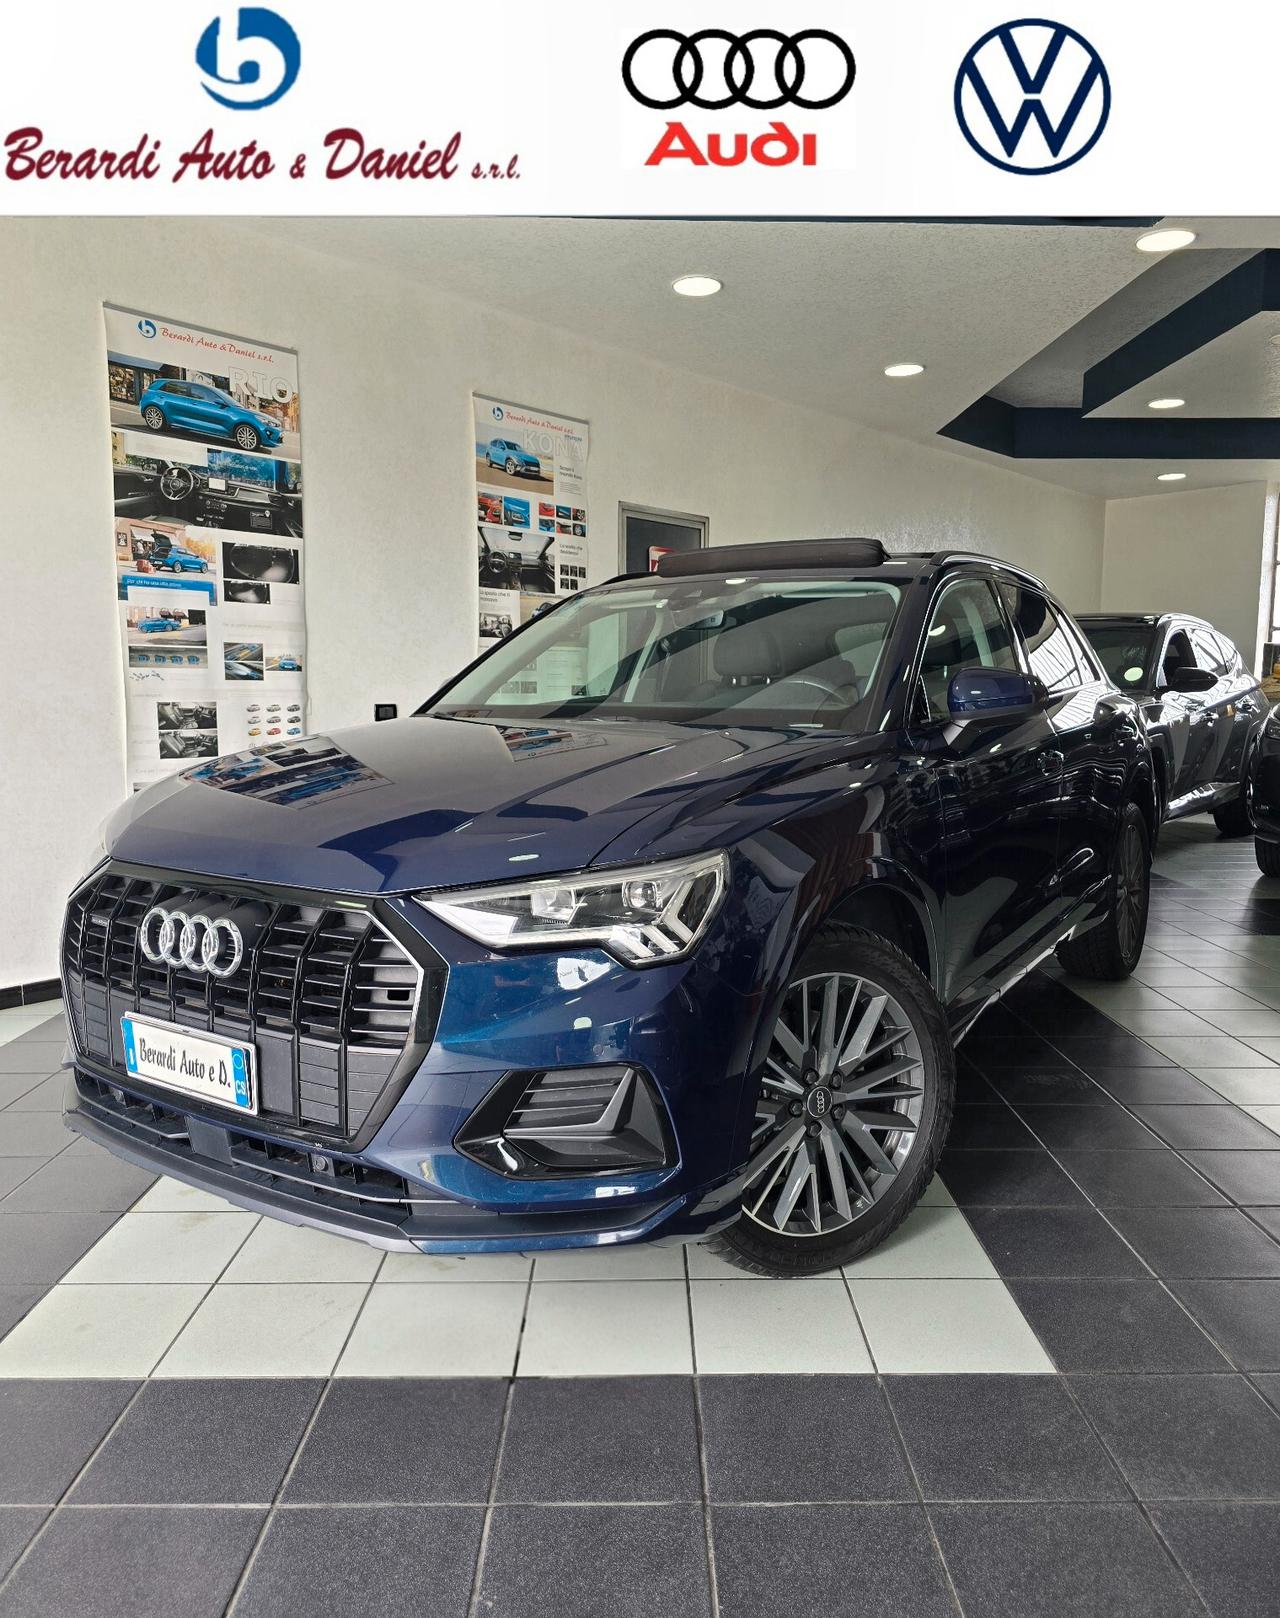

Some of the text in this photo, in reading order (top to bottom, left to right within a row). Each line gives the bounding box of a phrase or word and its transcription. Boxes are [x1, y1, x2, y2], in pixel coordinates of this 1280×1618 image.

[160, 327, 195, 344] Berardi
[195, 336, 218, 350] Auto
[219, 343, 227, 352] &
[226, 343, 256, 359] Daniel
[228, 366, 294, 404] RIO
[523, 430, 584, 461] KONA
[139, 1037, 177, 1072] Berardi
[179, 1049, 206, 1080] Auto
[208, 1064, 216, 1083] e
[234, 1079, 247, 1096] CS
